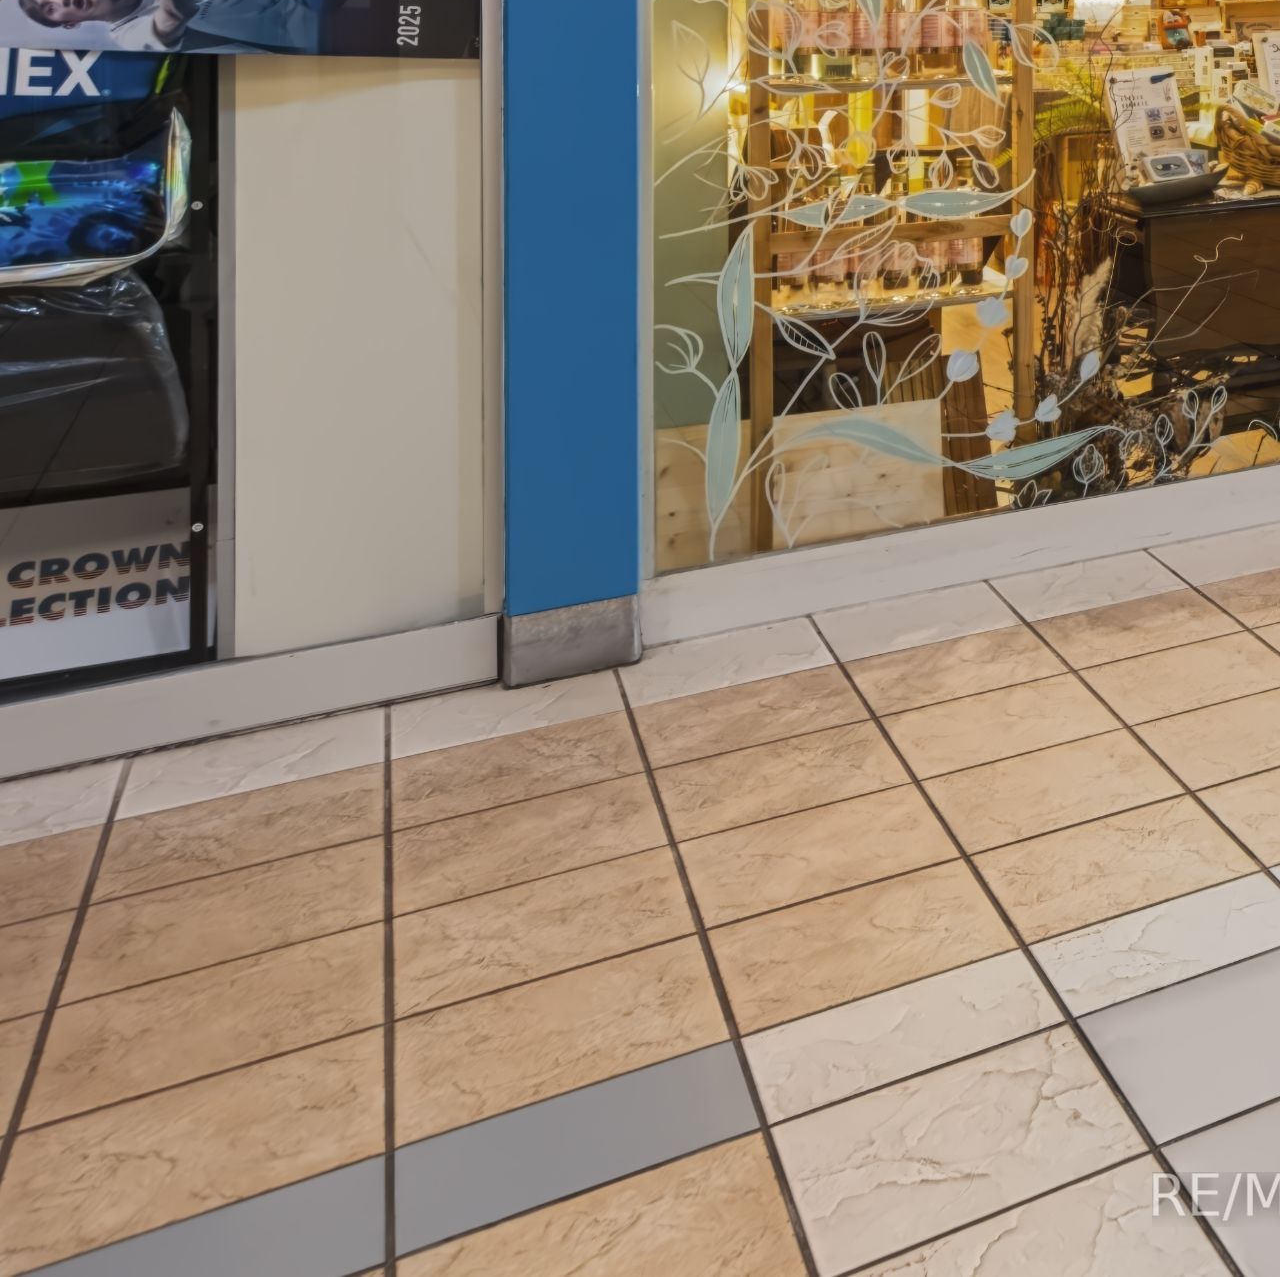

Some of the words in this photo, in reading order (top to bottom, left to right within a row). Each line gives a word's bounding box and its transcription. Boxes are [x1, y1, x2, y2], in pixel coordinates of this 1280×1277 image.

[396, 5, 422, 47] 2025
[0, 48, 102, 96] EX
[7, 541, 190, 589] CROWN
[0, 575, 190, 628] ECTION
